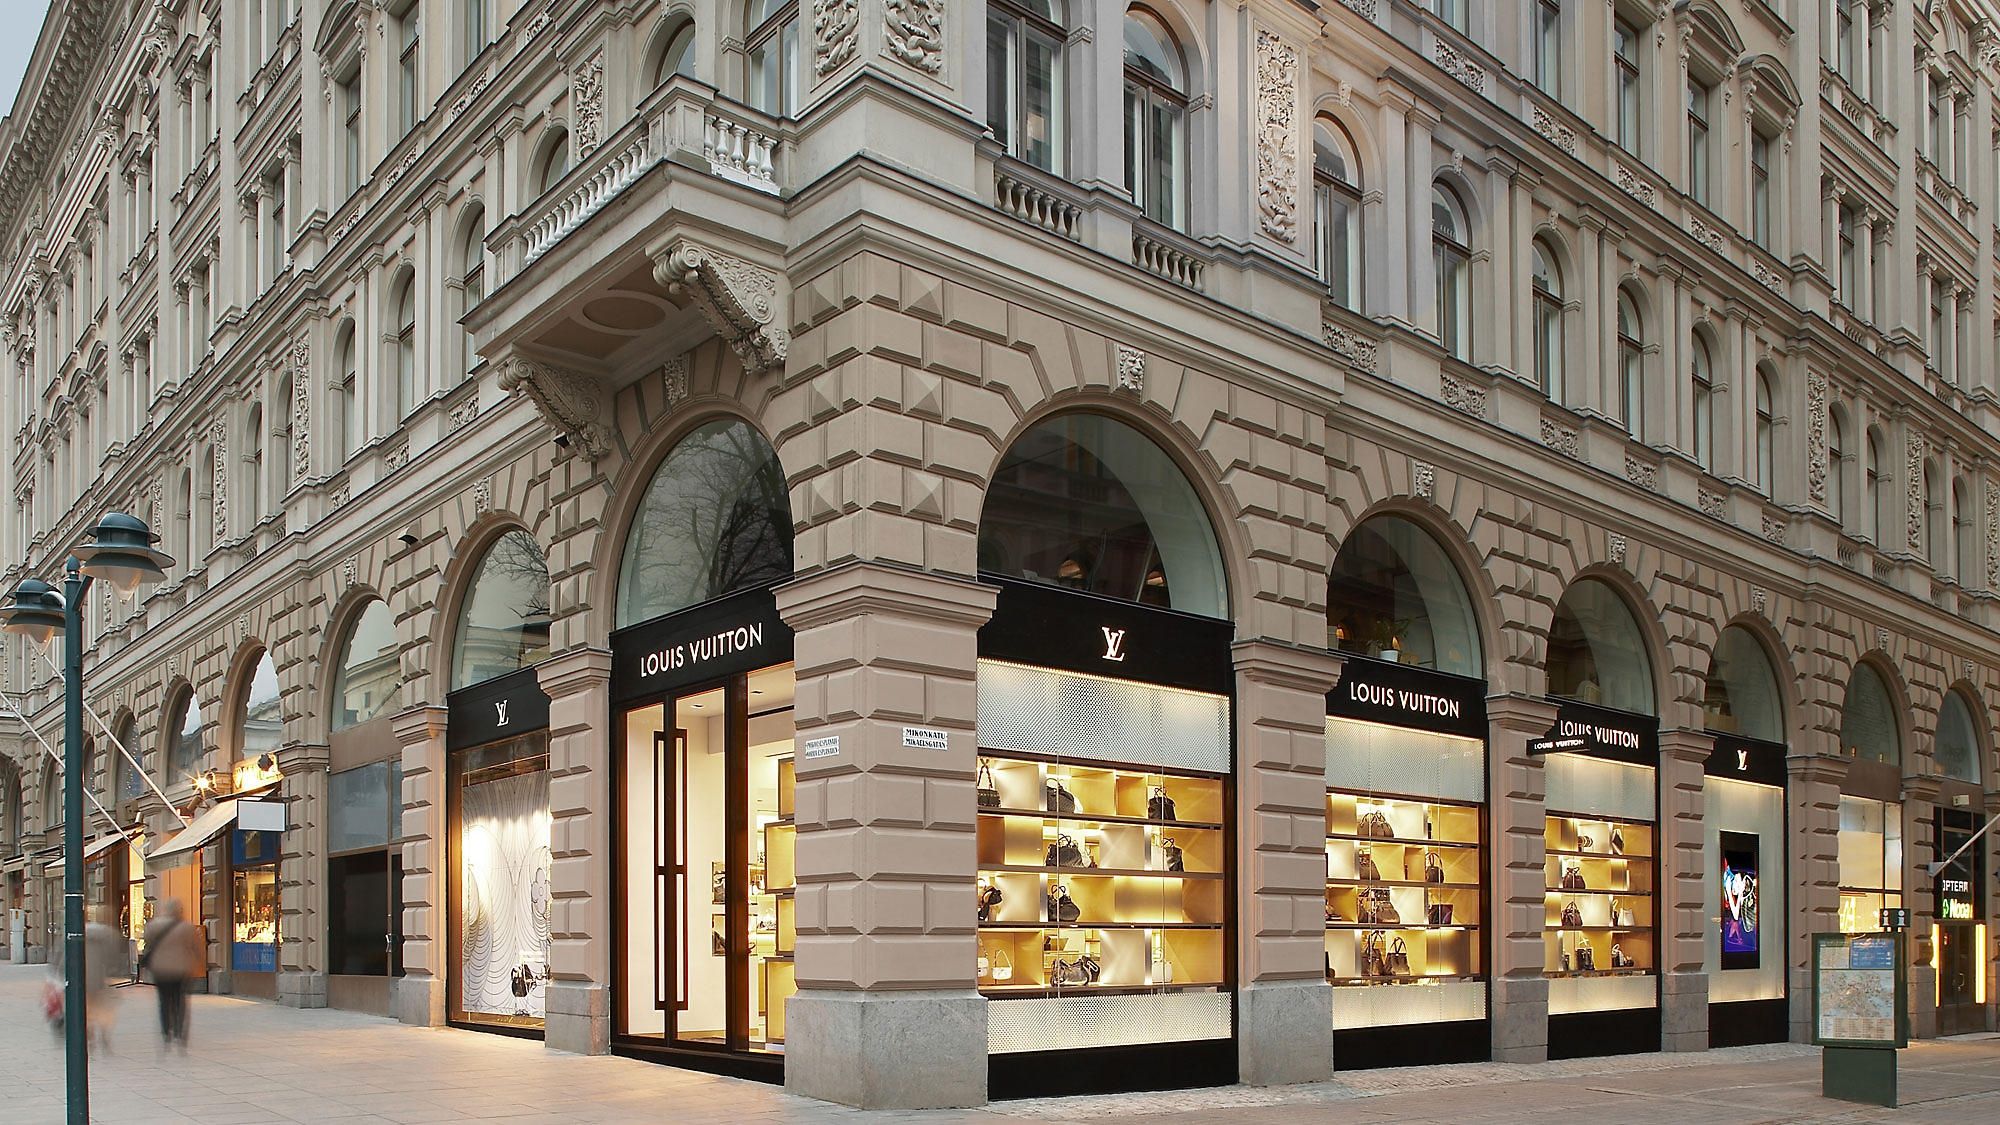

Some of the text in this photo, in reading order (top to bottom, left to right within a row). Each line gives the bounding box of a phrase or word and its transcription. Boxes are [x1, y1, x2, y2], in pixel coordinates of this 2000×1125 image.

[641, 622, 762, 678] LOUIS VUITTON
[1350, 681, 1460, 719] LOUIS VUITTON
[905, 728, 946, 740] MIKONKATU
[905, 737, 946, 748] MIKAELSGATAN
[1594, 726, 1639, 749] VUITTON
[1534, 739, 1585, 750] LOUIS VUITTON
